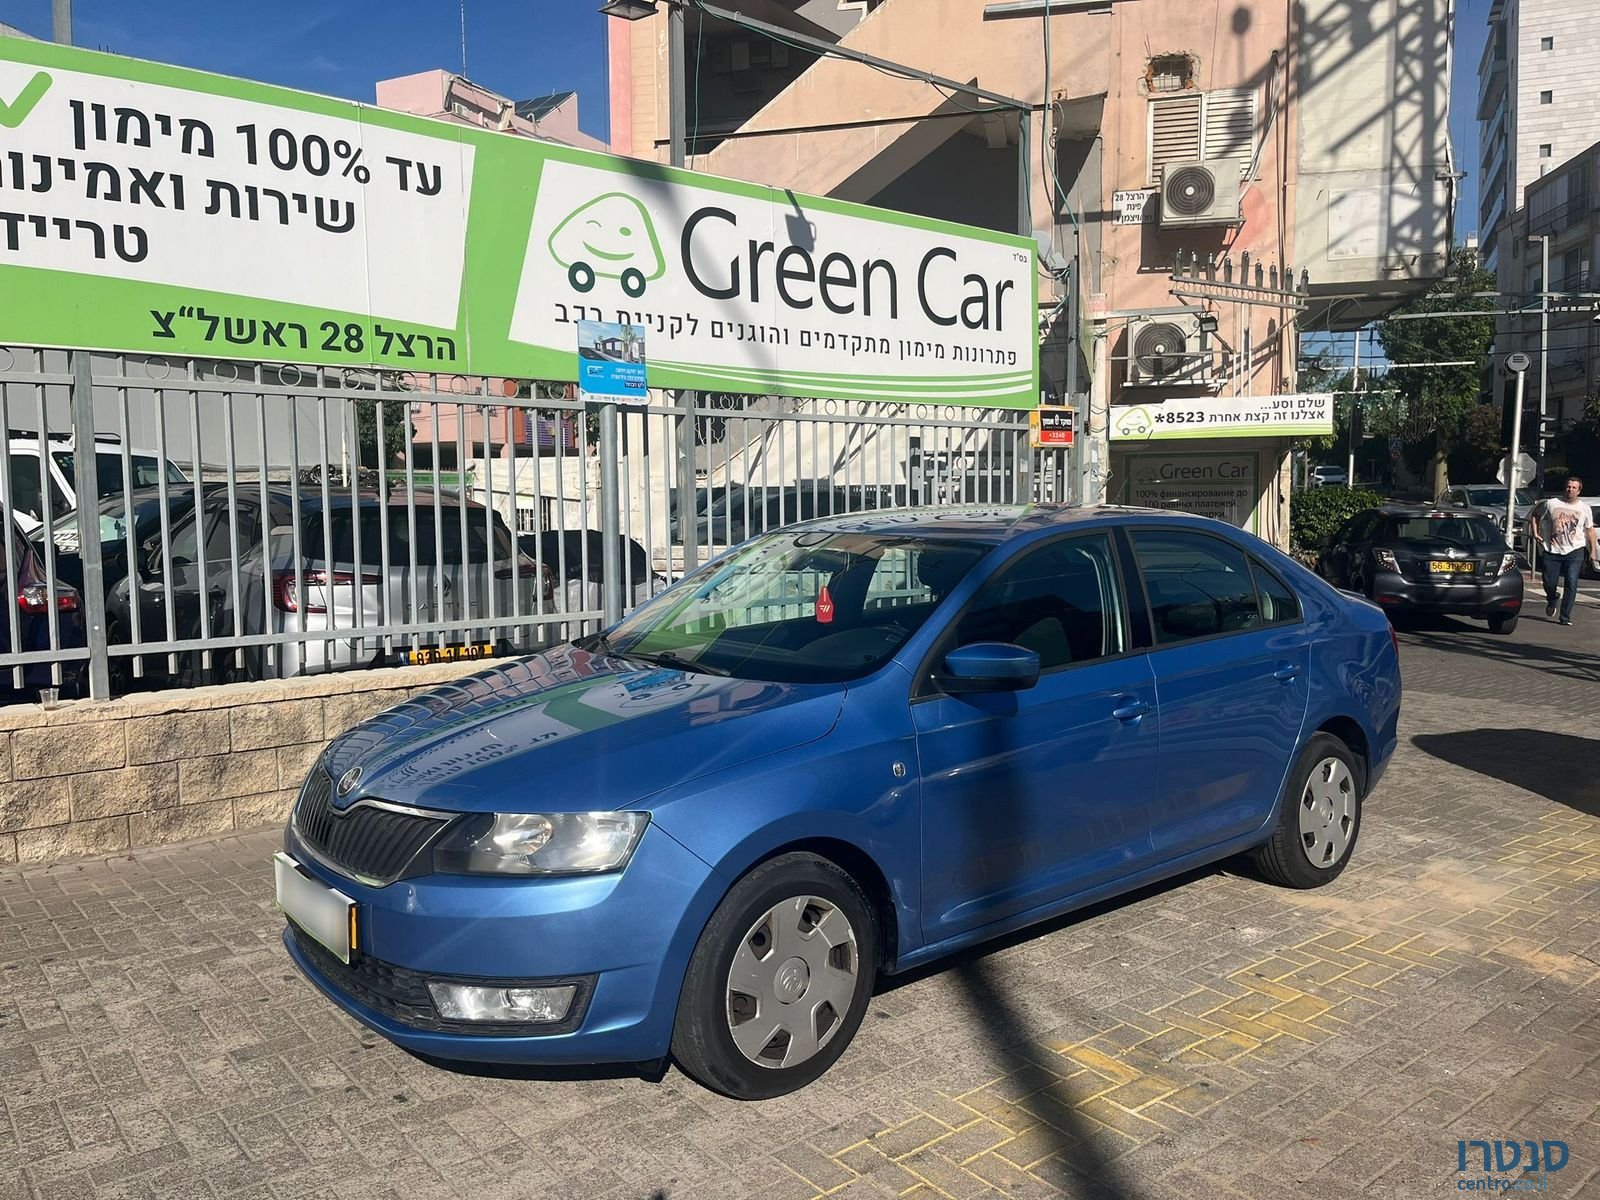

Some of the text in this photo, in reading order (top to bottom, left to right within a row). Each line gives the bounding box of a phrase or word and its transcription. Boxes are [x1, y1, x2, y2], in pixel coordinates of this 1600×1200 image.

[69, 99, 442, 197] עד 100% מימון
[0, 151, 355, 234] שירות ואמינו
[1115, 194, 1124, 202] 28
[1125, 192, 1145, 201] הרצל
[0, 211, 149, 264] טרייד
[680, 206, 1014, 332] Green Car
[149, 305, 456, 361] הרצל 28 ראשל"צ
[711, 320, 790, 347] והוגנים
[799, 330, 891, 357] מתקדמים
[899, 340, 945, 361] מימון
[952, 345, 1017, 366] פתרונות
[1298, 398, 1325, 409] שלם
[1208, 413, 1241, 423] אחרת
[1244, 412, 1270, 423] קצת
[1273, 411, 1287, 421] זה
[1291, 409, 1325, 420] אצלנו
[1160, 462, 1249, 480] Green Car
[1135, 489, 1248, 501] 100% финансирование до
